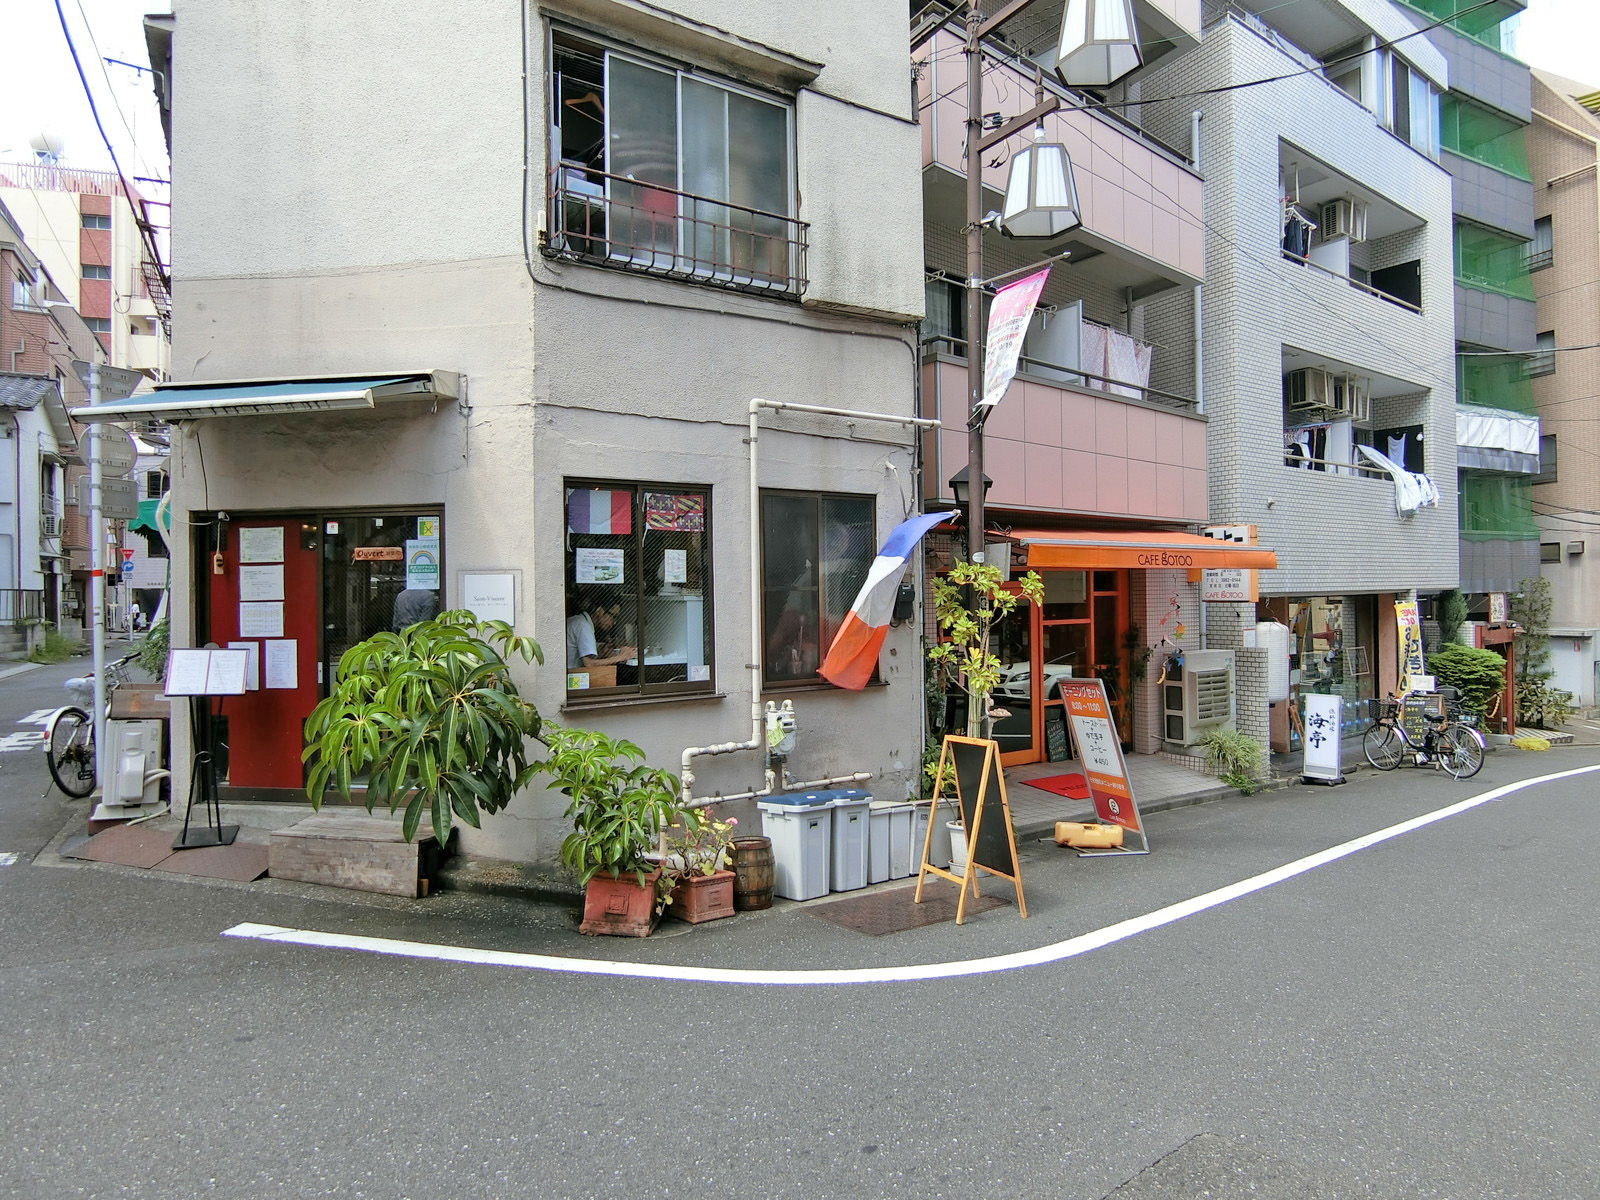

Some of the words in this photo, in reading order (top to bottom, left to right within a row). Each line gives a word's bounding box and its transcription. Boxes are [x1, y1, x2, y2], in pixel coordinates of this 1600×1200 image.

[1138, 554, 1159, 566] CAFE
[1062, 686, 1101, 698] モーニングセット
[1308, 712, 1330, 749] 海亭
[1089, 745, 1107, 754] コーヒー
